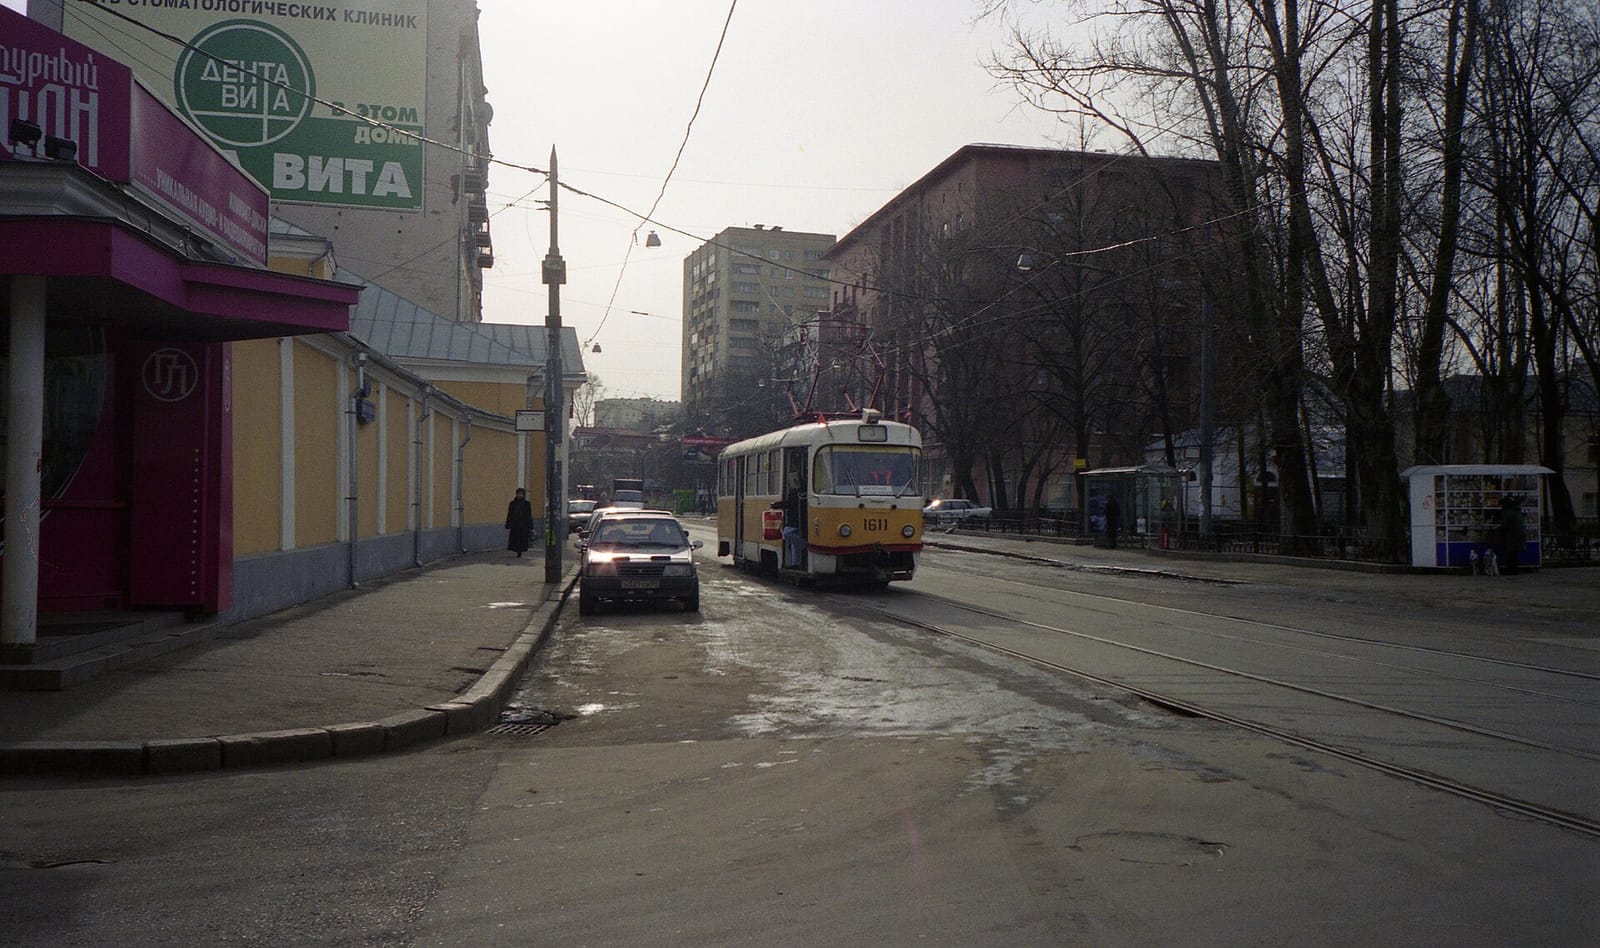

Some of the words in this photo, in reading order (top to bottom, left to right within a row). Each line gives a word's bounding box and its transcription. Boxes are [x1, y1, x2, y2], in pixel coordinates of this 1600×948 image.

[344, 9, 417, 29] КЛИНИК
[200, 58, 291, 87] ДЕНТА
[331, 102, 345, 117] В
[357, 101, 418, 122] ЭТОМ
[354, 125, 419, 146] ДОМЕ
[272, 152, 412, 198] ВИТА
[863, 518, 888, 531] 1611
